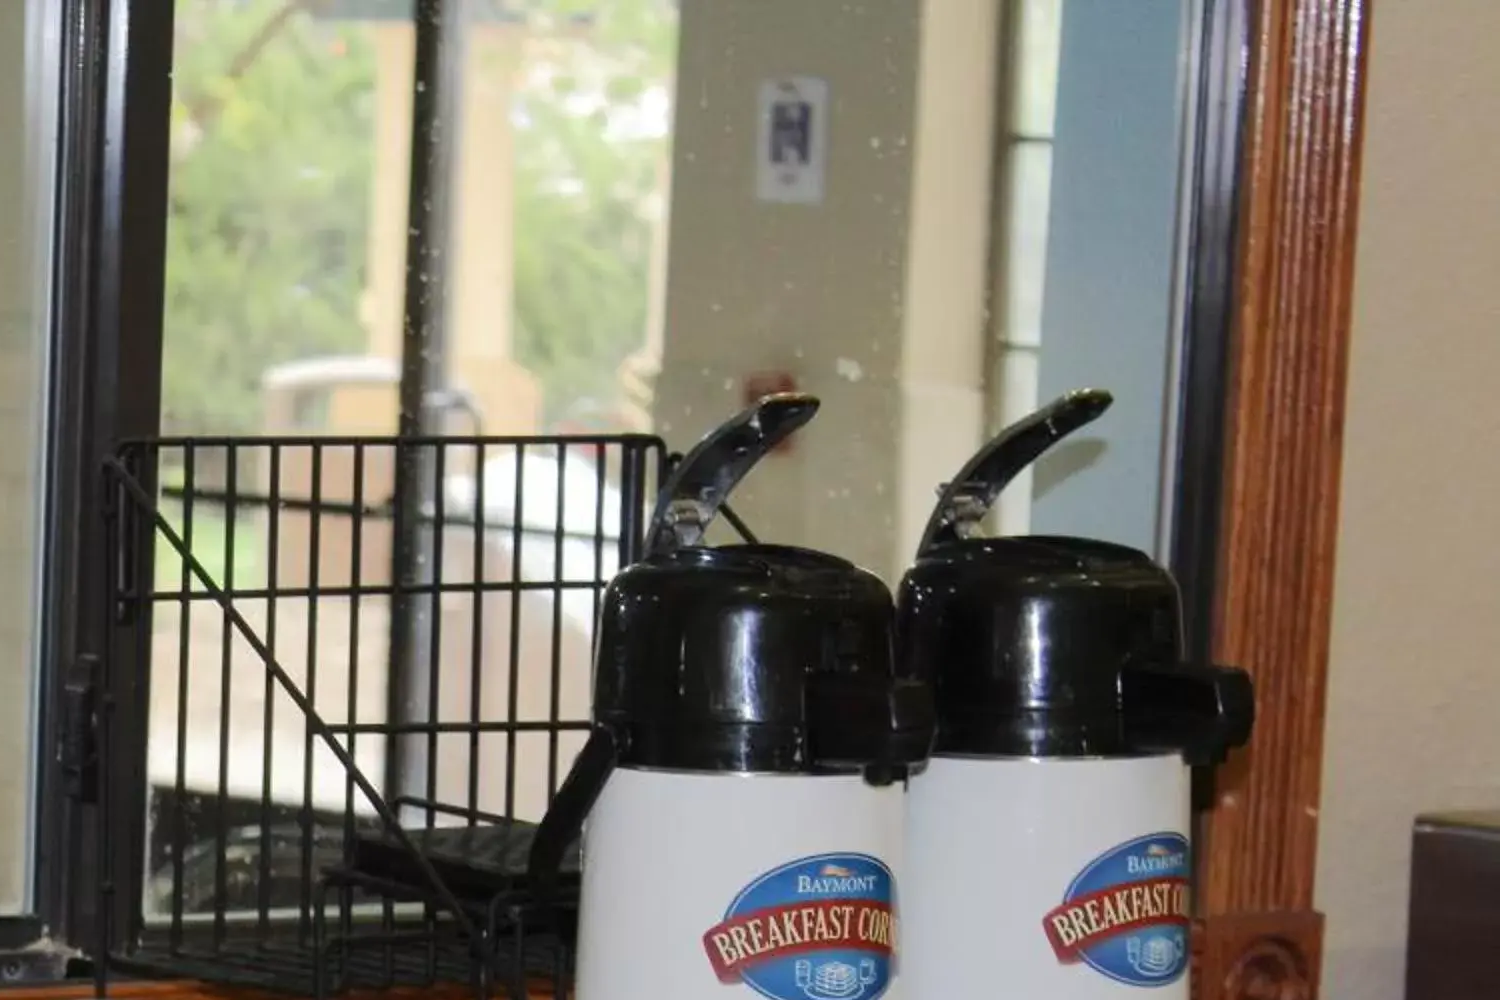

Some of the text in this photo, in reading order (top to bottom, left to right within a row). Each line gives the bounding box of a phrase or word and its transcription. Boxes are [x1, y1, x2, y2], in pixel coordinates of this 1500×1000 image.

[797, 875, 877, 893] BAYMONT
[712, 905, 853, 966] BREAKFAST
[1051, 883, 1171, 947] BREAKFAST
